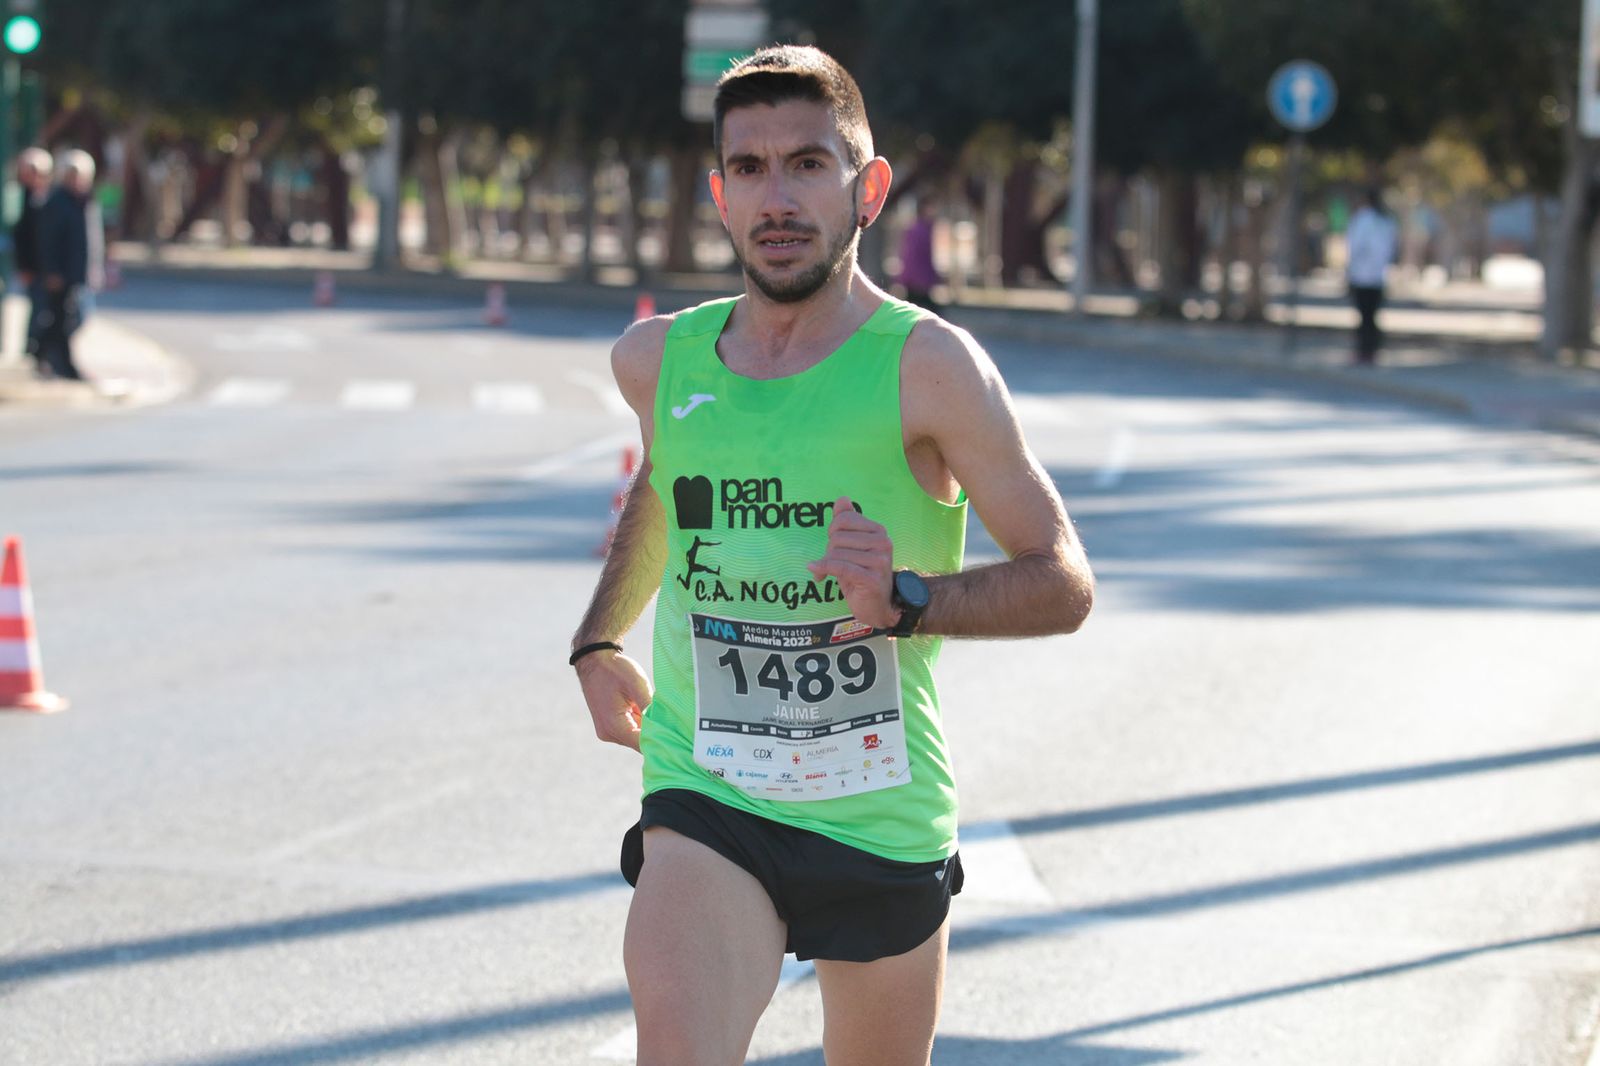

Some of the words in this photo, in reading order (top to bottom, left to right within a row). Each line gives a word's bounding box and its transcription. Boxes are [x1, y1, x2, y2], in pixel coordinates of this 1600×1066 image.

[721, 477, 783, 511] pan
[728, 501, 863, 529] moren
[695, 581, 734, 602] C.A.
[742, 624, 769, 635] Medio
[772, 627, 812, 637] Maratón
[744, 633, 782, 646] Almería
[783, 635, 813, 647] 2022
[718, 645, 877, 704] 1489
[773, 703, 820, 720] JAIME
[753, 748, 773, 759] CDX
